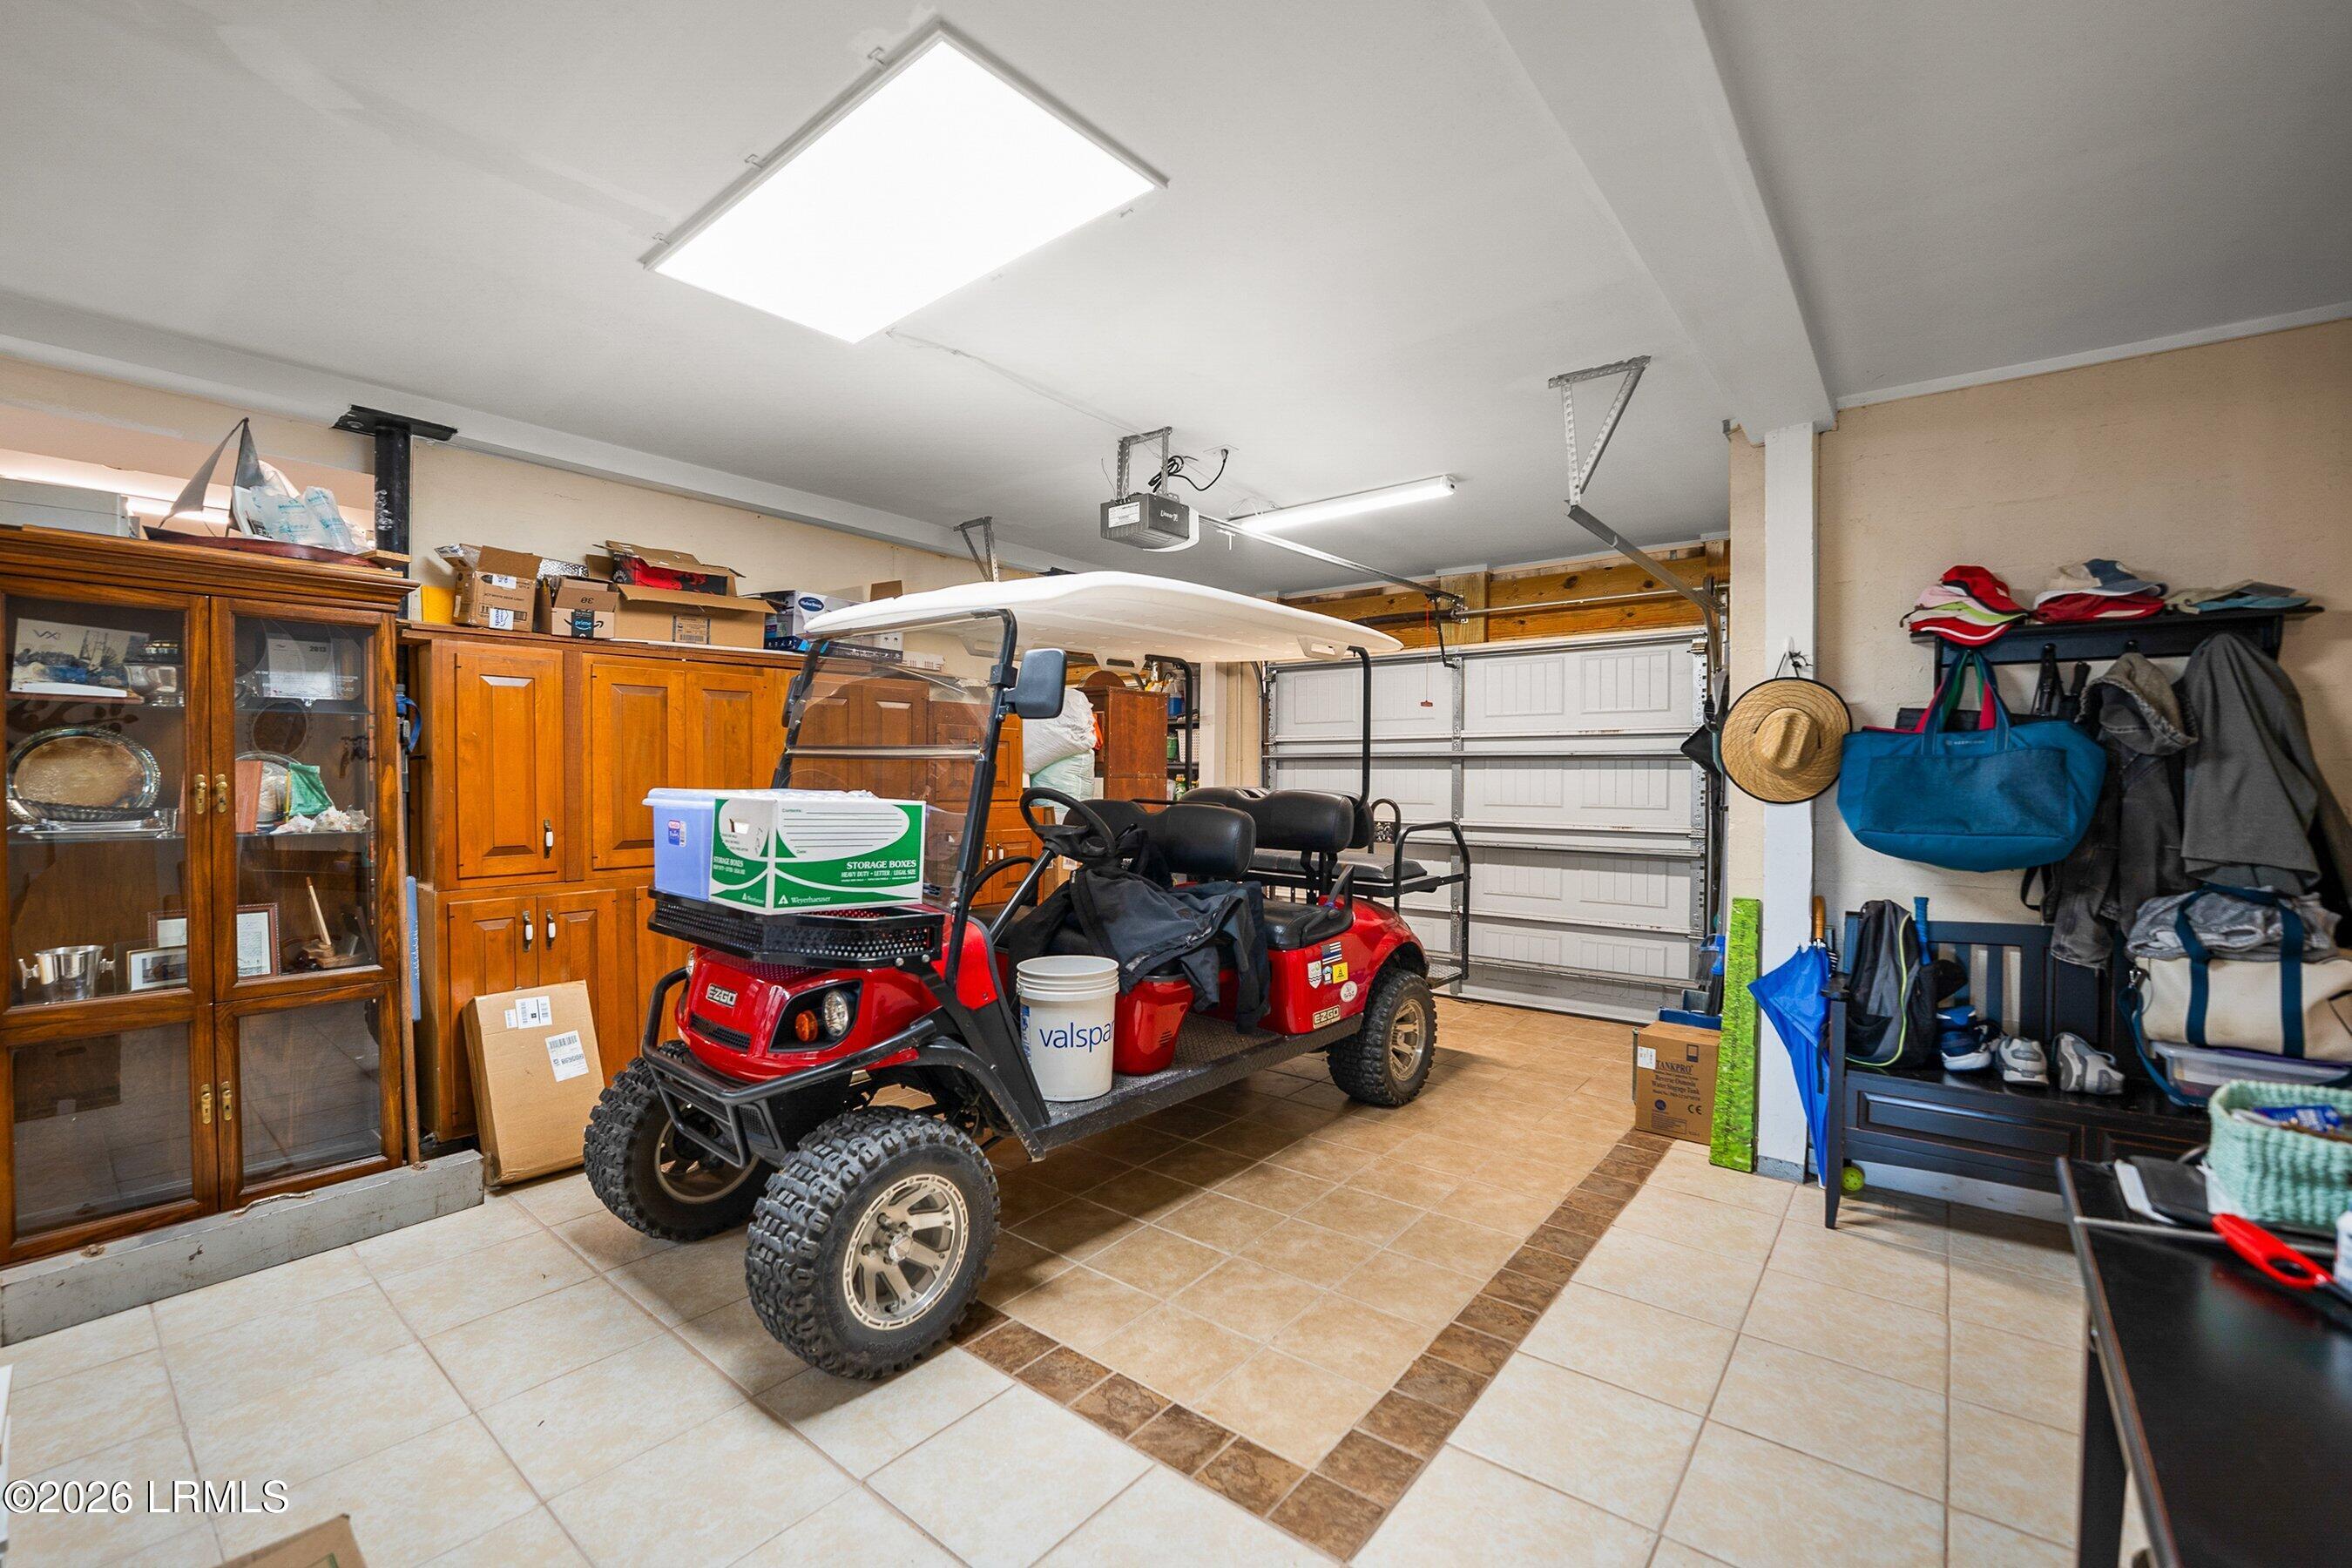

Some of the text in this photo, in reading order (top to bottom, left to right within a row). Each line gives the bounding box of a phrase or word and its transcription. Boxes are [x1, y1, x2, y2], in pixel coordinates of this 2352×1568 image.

[847, 859, 916, 869] STORAGE BOXES
[791, 896, 831, 905] Weyerhaeuser
